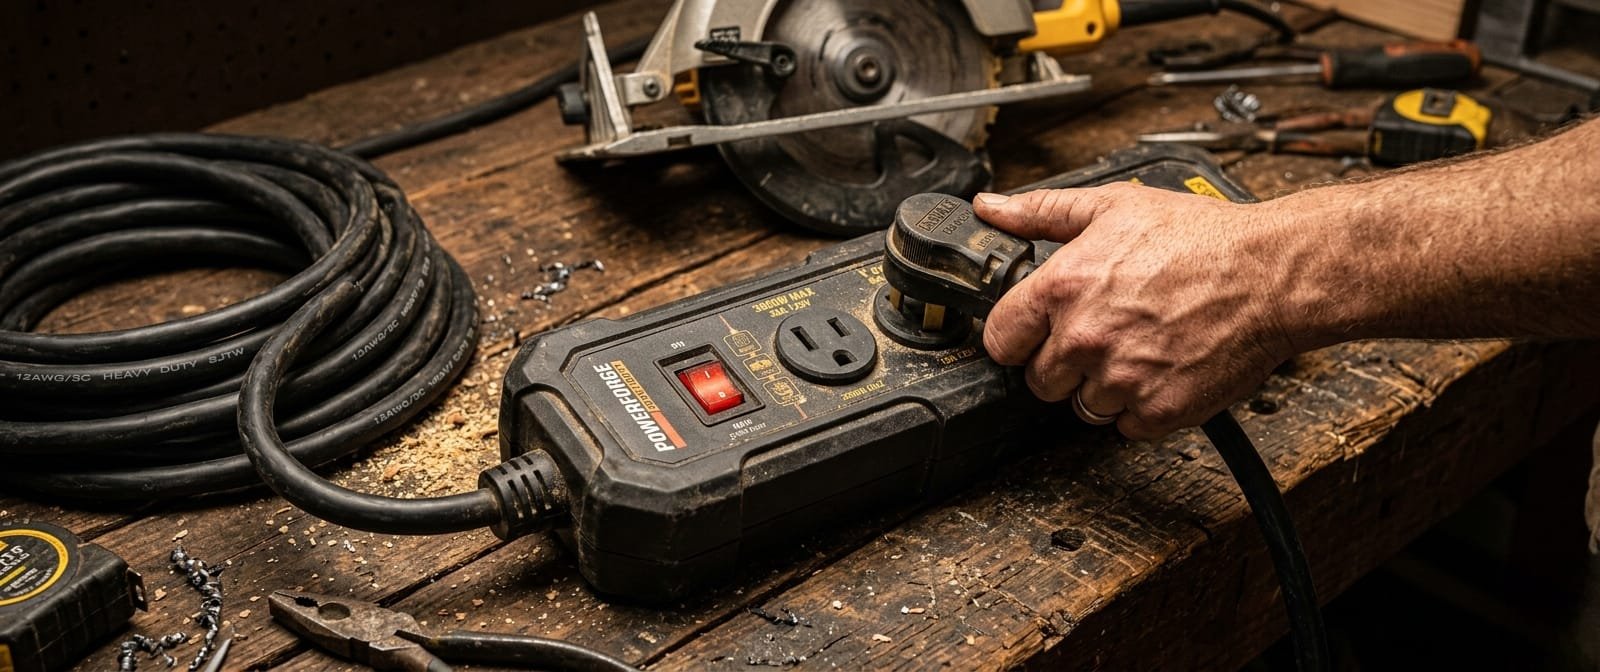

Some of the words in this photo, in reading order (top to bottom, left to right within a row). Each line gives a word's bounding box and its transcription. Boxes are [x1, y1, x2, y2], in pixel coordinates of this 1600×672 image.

[103, 368, 152, 381] HEAVY
[160, 359, 199, 374] DUTY
[208, 346, 245, 364] SJTW
[592, 362, 676, 452] POWERFORGE
